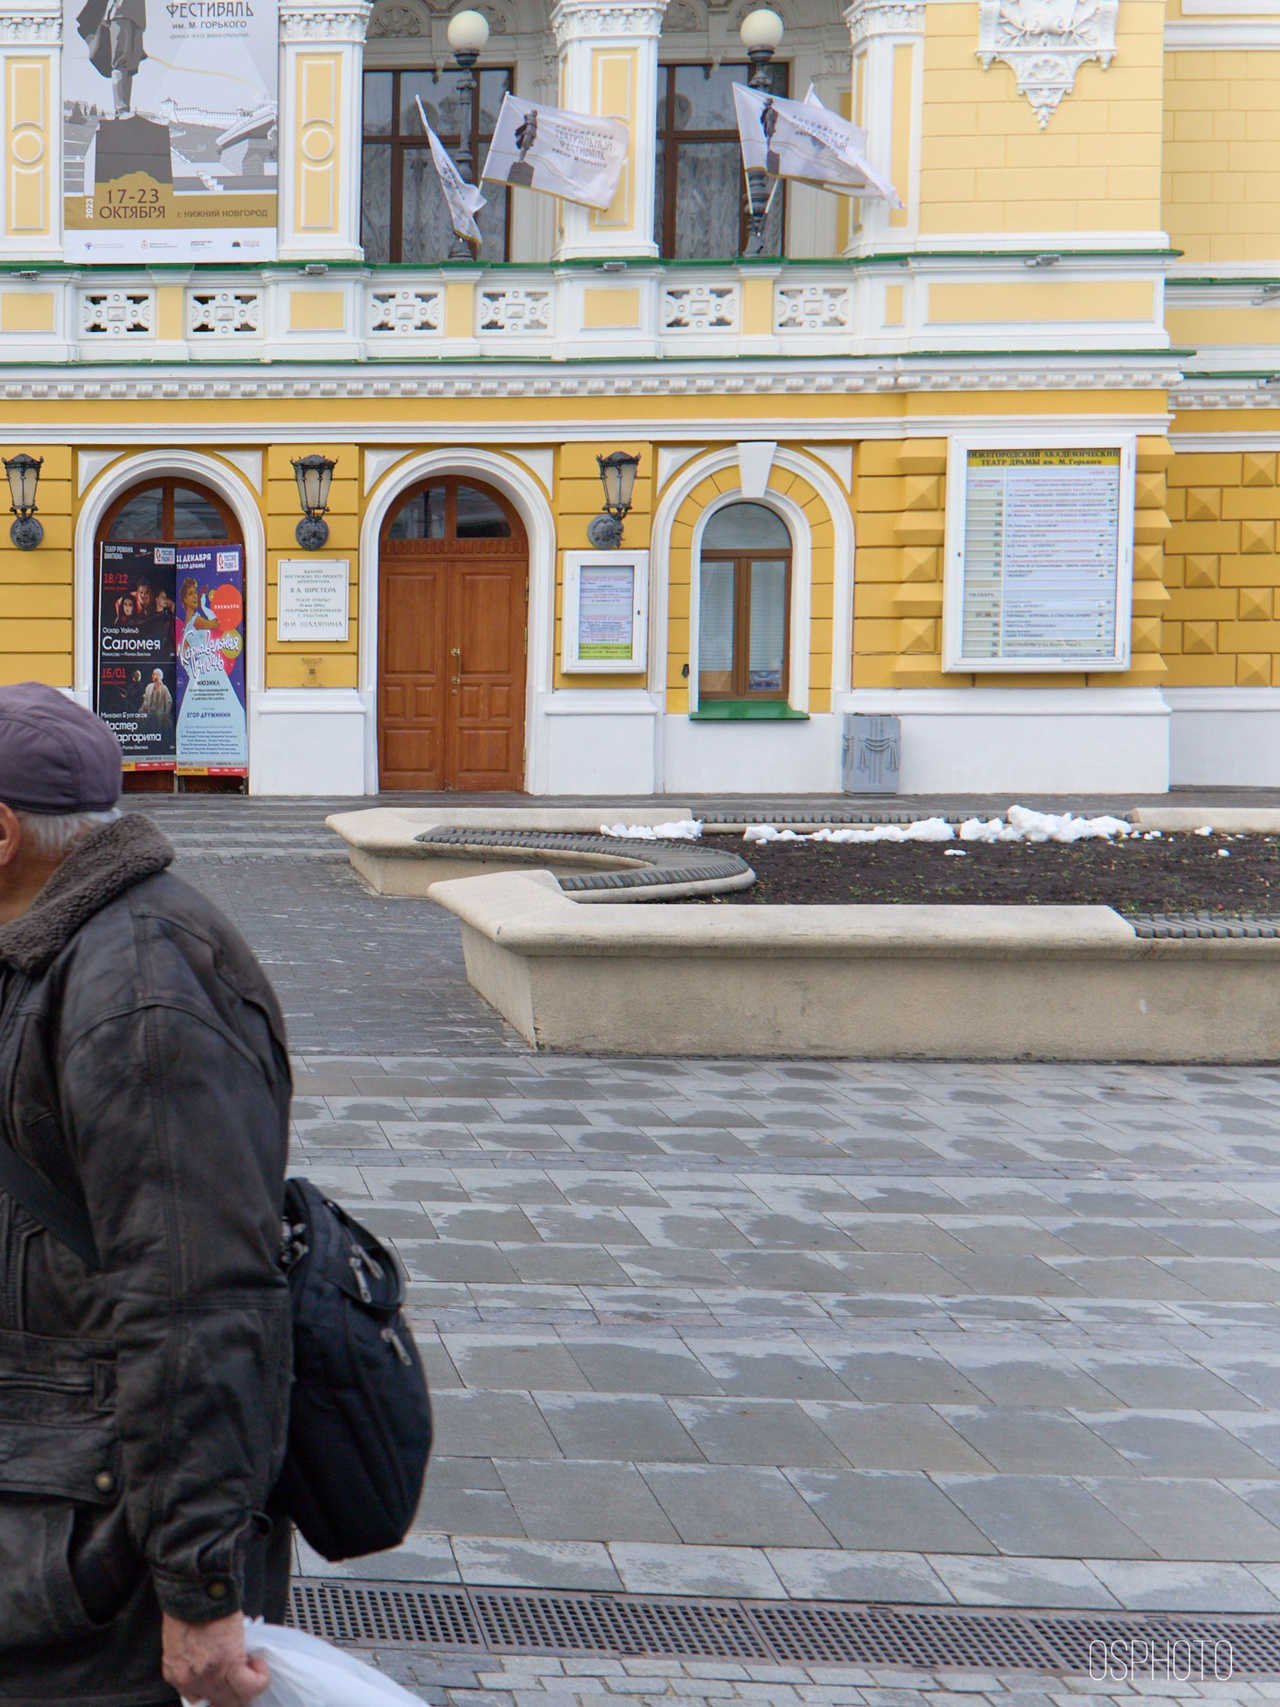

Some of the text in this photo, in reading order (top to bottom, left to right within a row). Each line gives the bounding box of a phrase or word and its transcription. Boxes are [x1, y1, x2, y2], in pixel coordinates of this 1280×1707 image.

[166, 2, 254, 18] ФЕСТИВАЛЬ
[200, 20, 248, 29] ГОРЬКОГО
[556, 124, 613, 140] РОССИЙСКИЙ
[556, 130, 613, 151] ТЕАТРАЛЬНЫЙ
[108, 189, 160, 204] 17-23
[85, 198, 94, 219] 2023
[99, 206, 166, 219] ОКТЯБРЯ
[184, 209, 220, 218] НИЖНИЙ
[222, 209, 268, 218] НОВГОРОД
[1043, 450, 1119, 458] АКАДЕМИЧЕСКИЙ
[1009, 458, 1040, 466] ДРАМЫ
[1069, 458, 1102, 466] Горького
[183, 553, 211, 563] ДЕКАБРЯ
[104, 573, 128, 584] 18/12
[102, 626, 140, 635] Оскар Уайльд
[101, 636, 161, 651] Саломея
[177, 629, 239, 666] Карнавальная
[101, 668, 127, 679] 15/01
[122, 711, 148, 719] Булгаков
[200, 711, 231, 719] ДРУЖИНИН
[106, 720, 138, 732] астер
[114, 732, 161, 744] аргарита
